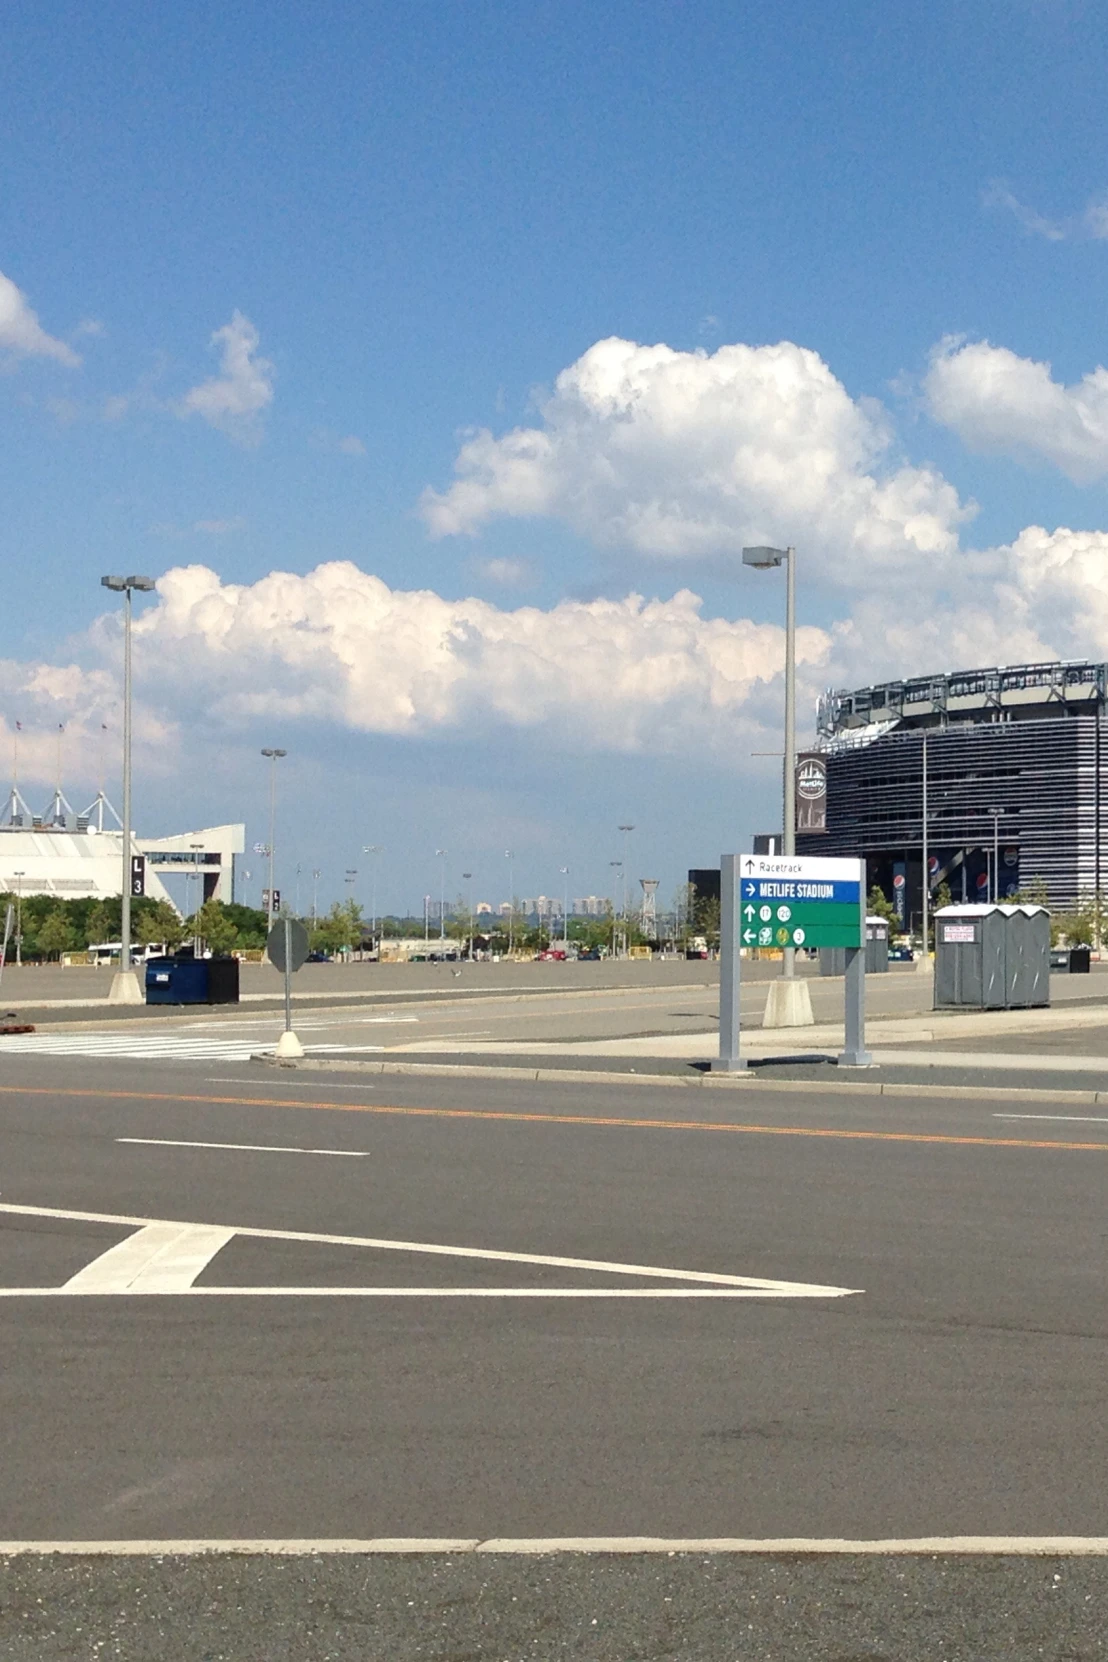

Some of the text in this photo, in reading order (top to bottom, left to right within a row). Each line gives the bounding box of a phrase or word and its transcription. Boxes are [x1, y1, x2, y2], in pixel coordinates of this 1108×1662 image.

[134, 859, 142, 872] L
[760, 862, 802, 873] Racetrack
[134, 880, 142, 893] 3
[760, 883, 834, 898] METLIFE STADIUM
